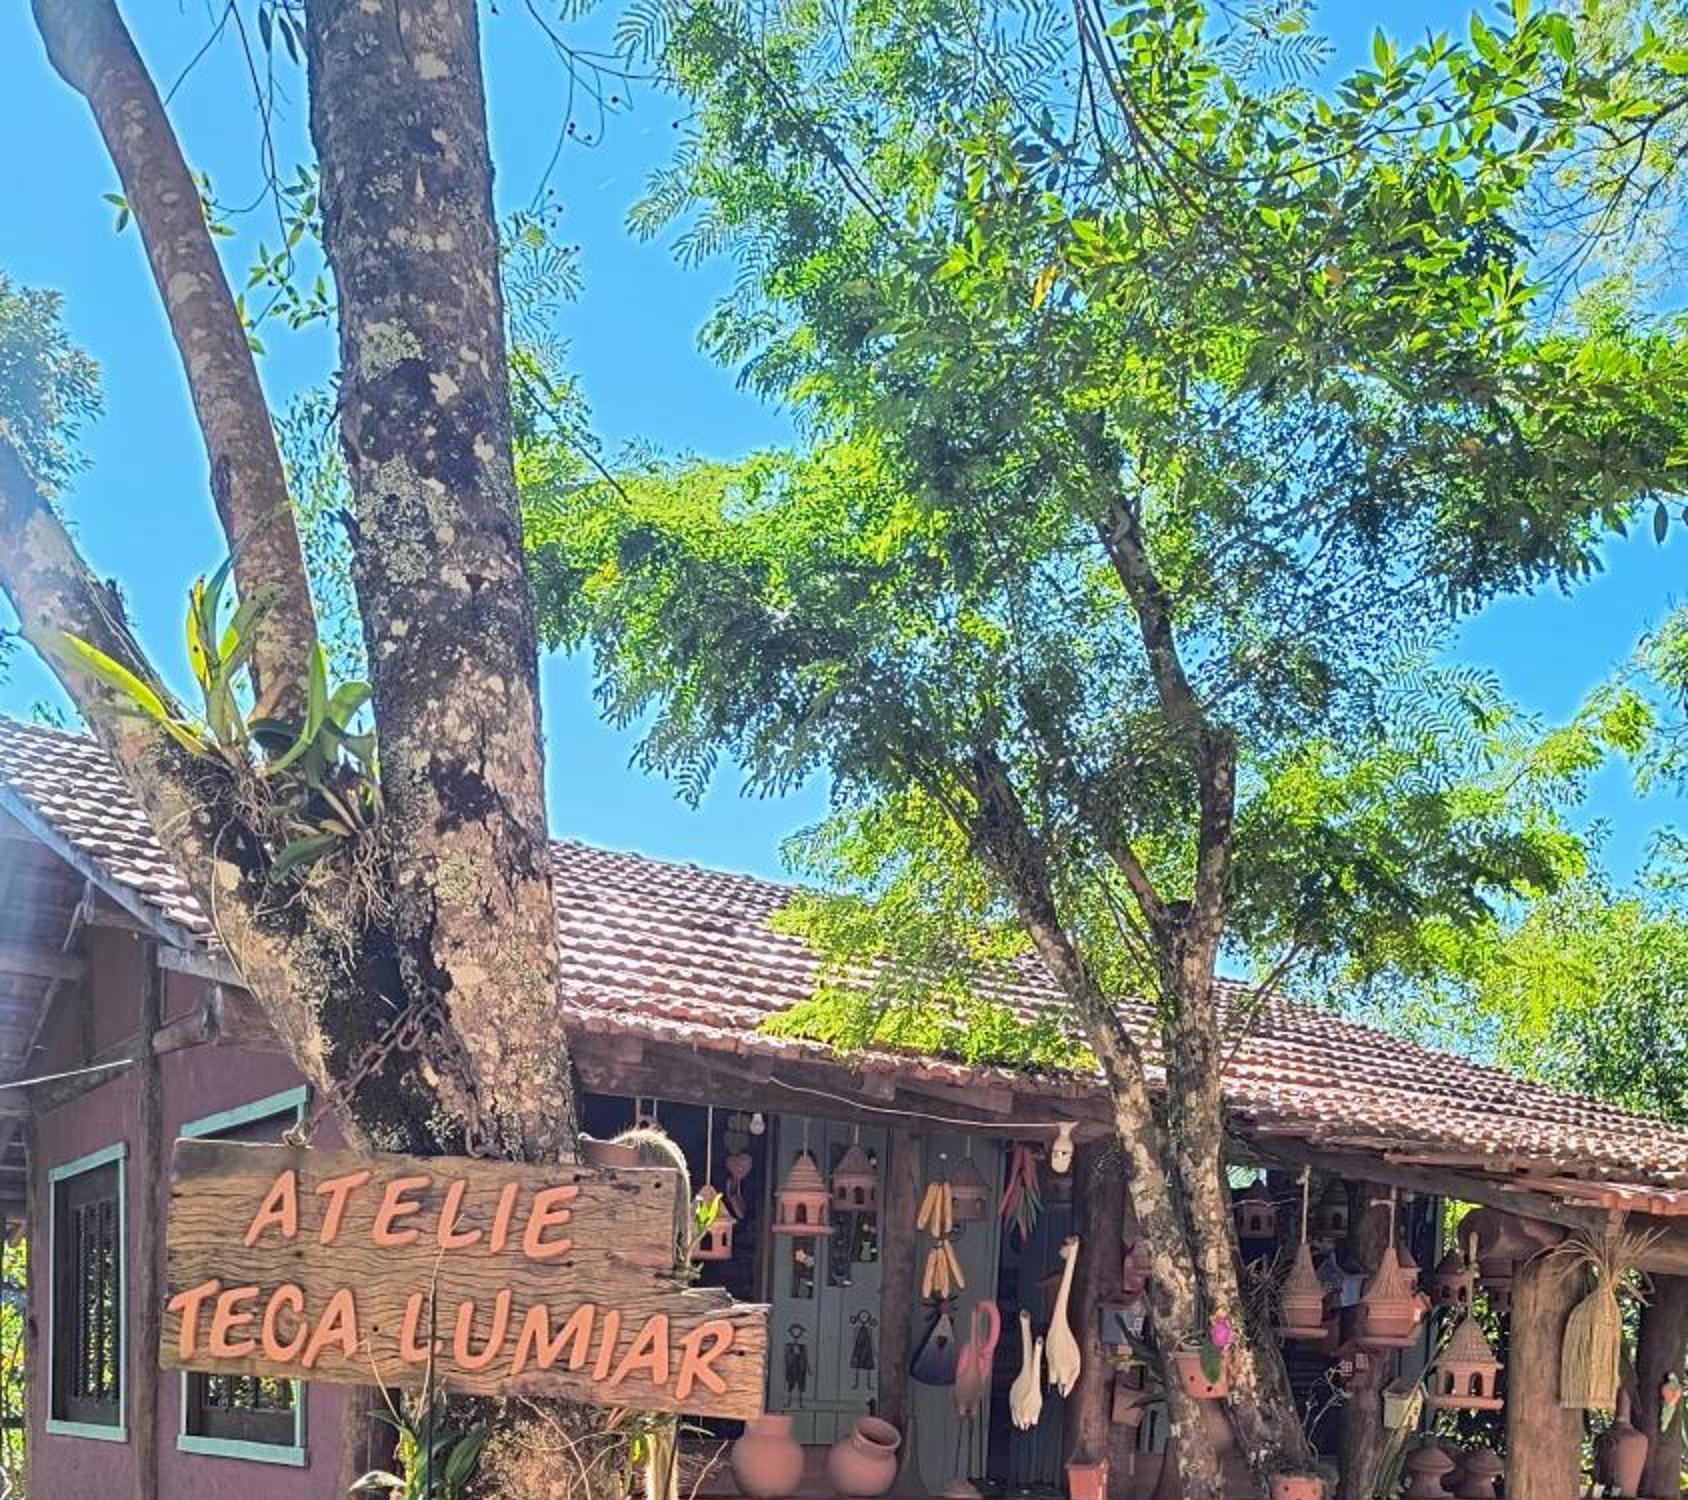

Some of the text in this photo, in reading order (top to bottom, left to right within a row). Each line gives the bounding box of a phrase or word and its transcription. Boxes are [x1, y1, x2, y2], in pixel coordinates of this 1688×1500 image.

[244, 1169, 580, 1260] ATELIE
[167, 1279, 735, 1400] TECA LUMIAR
